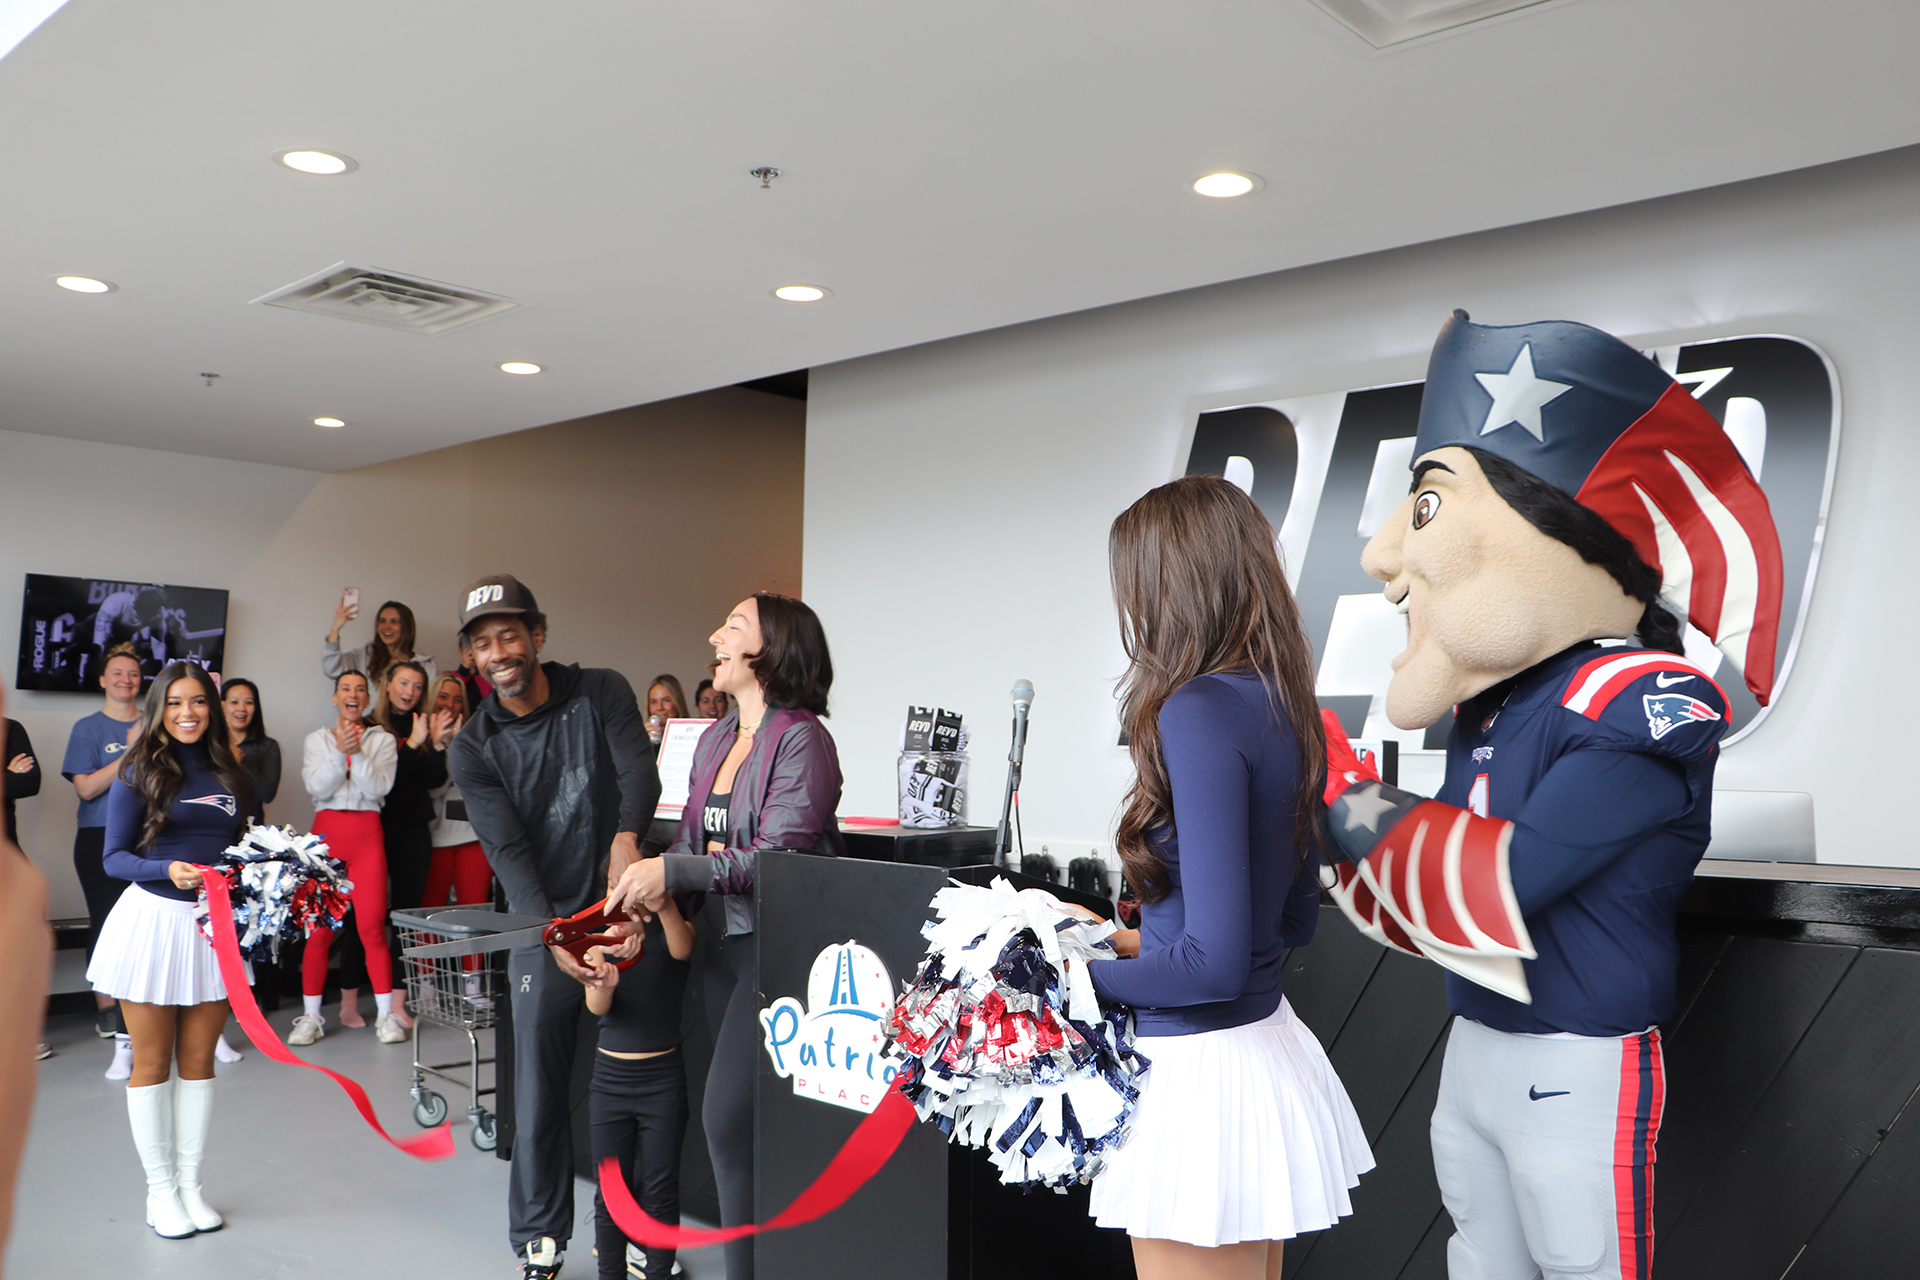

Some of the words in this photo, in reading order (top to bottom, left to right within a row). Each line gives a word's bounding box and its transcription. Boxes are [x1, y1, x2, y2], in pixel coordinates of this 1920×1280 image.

[33, 620, 47, 669] ROGUE
[765, 1004, 898, 1084] Patrio
[798, 1078, 870, 1106] PLAC
